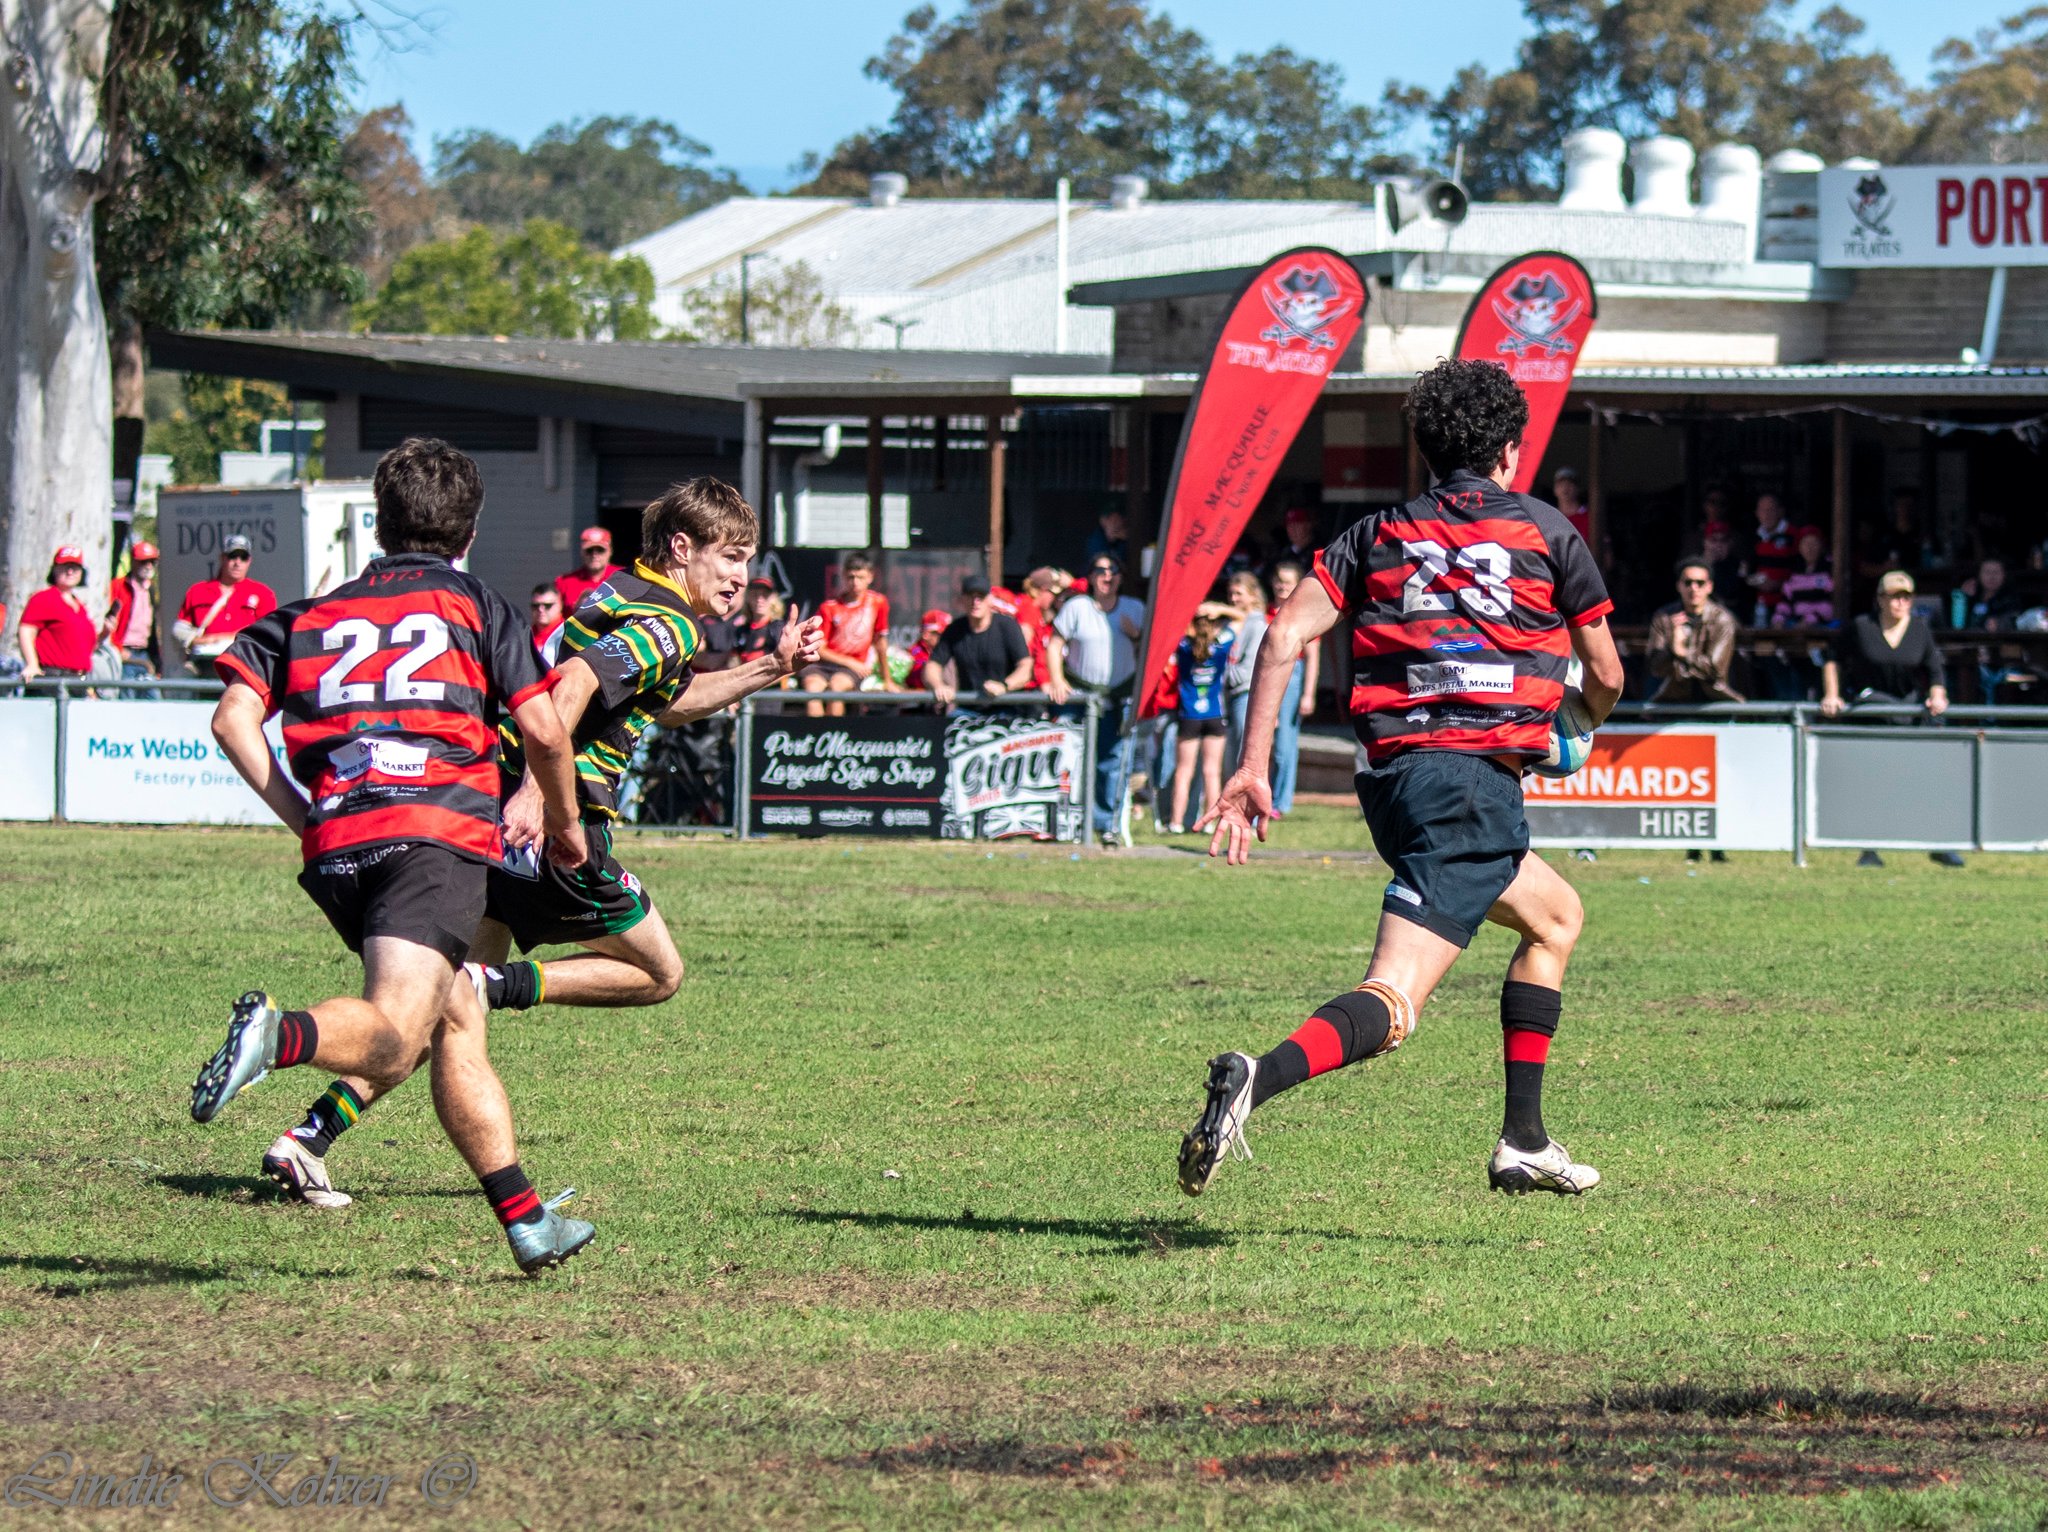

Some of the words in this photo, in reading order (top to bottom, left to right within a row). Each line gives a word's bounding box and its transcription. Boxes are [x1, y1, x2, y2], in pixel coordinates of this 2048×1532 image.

[1936, 177, 2048, 247] PORT
[1175, 519, 1206, 568] PORT
[1205, 405, 1270, 510] MACQUARIE
[368, 569, 424, 587] 1973
[1402, 540, 1512, 617] 23
[319, 613, 449, 708] 22
[1469, 680, 1513, 688] MARKET
[88, 737, 134, 759] Max
[141, 737, 207, 760] Webb
[764, 731, 815, 757] Port
[814, 730, 932, 764] Macquarie's
[134, 770, 196, 789] Factory
[201, 771, 244, 786] Direc
[382, 760, 424, 771] MARKET
[760, 757, 834, 790] Largest
[831, 757, 880, 790] Sign
[882, 757, 936, 790] Shop
[1639, 811, 1710, 836] HIRE
